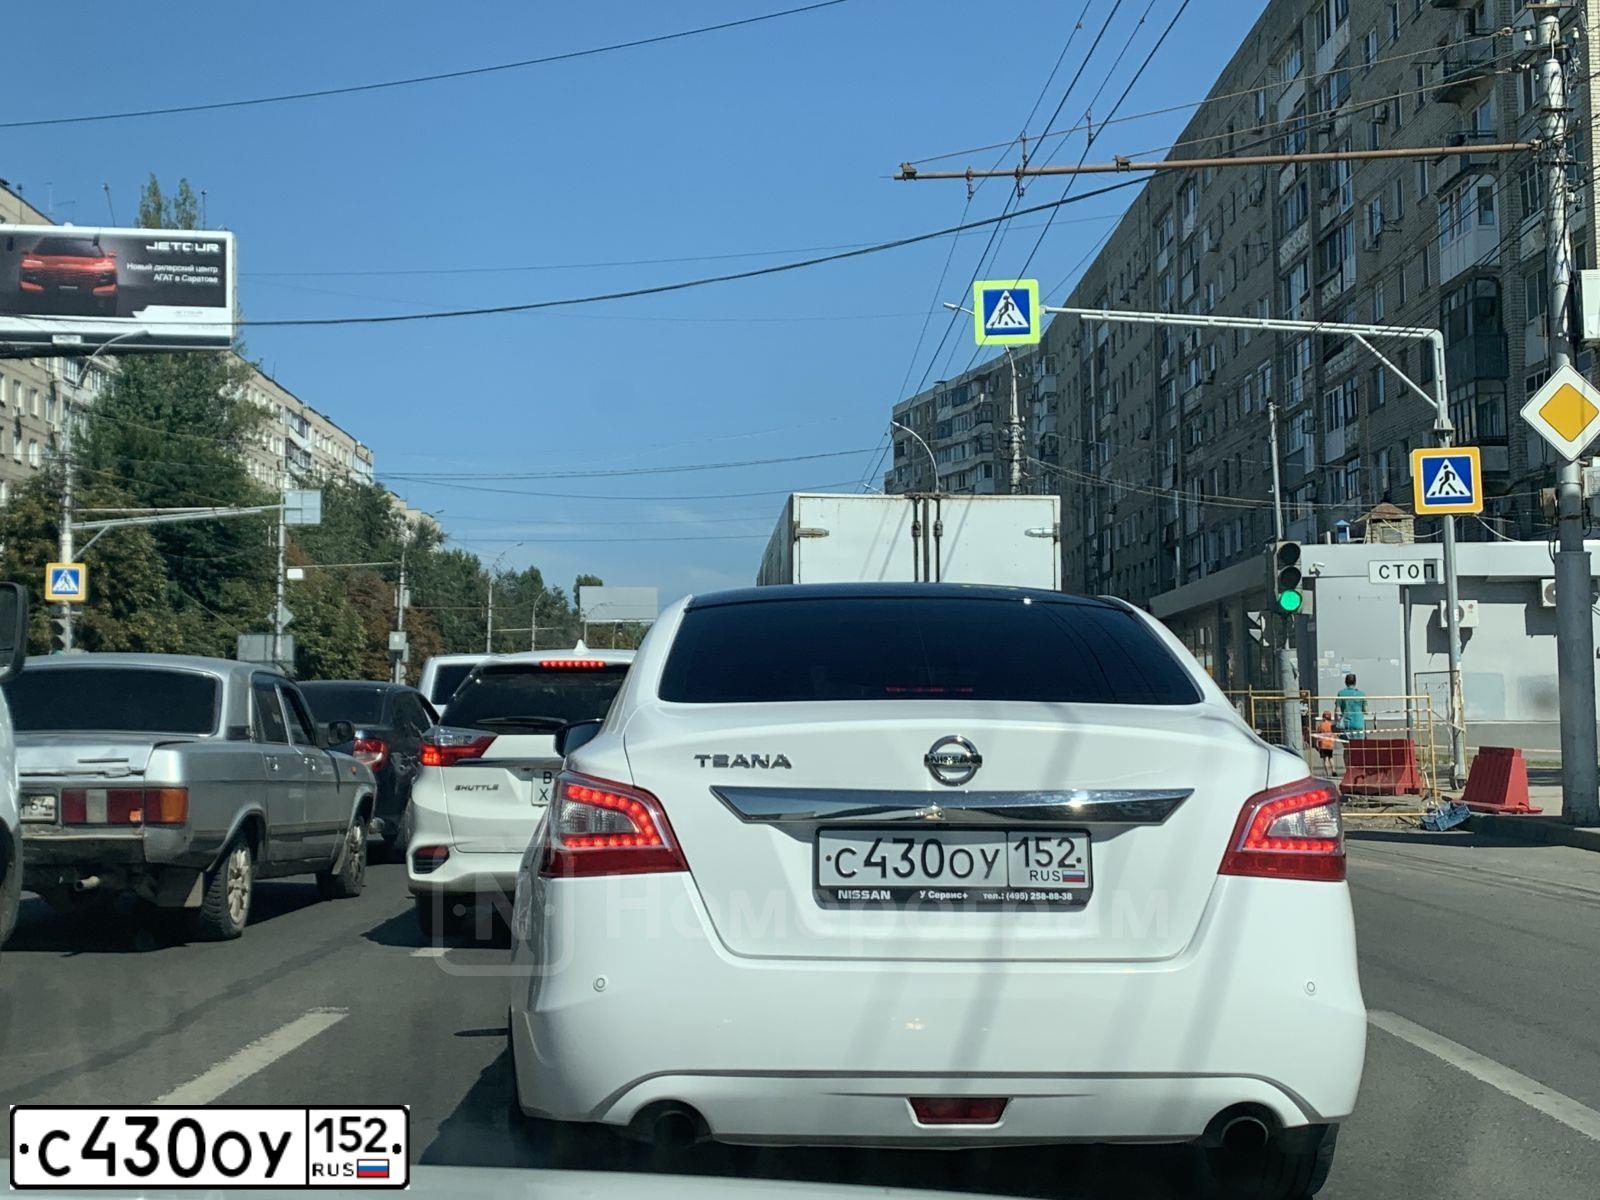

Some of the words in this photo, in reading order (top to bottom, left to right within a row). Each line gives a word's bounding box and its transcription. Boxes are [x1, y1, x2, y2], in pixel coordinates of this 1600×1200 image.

[126, 262, 152, 271] Новый
[153, 263, 195, 273] дилерский
[195, 265, 218, 273] центр
[153, 273, 173, 281] АГАТ
[181, 274, 218, 284] Саратове
[1379, 564, 1435, 579] СТОП
[694, 753, 792, 769] TEANA
[835, 837, 1000, 880] С430ОУ
[1014, 836, 1076, 868] 152
[1029, 869, 1061, 882] RUS
[838, 890, 891, 900] NISSAN
[1005, 892, 1029, 902] (495)
